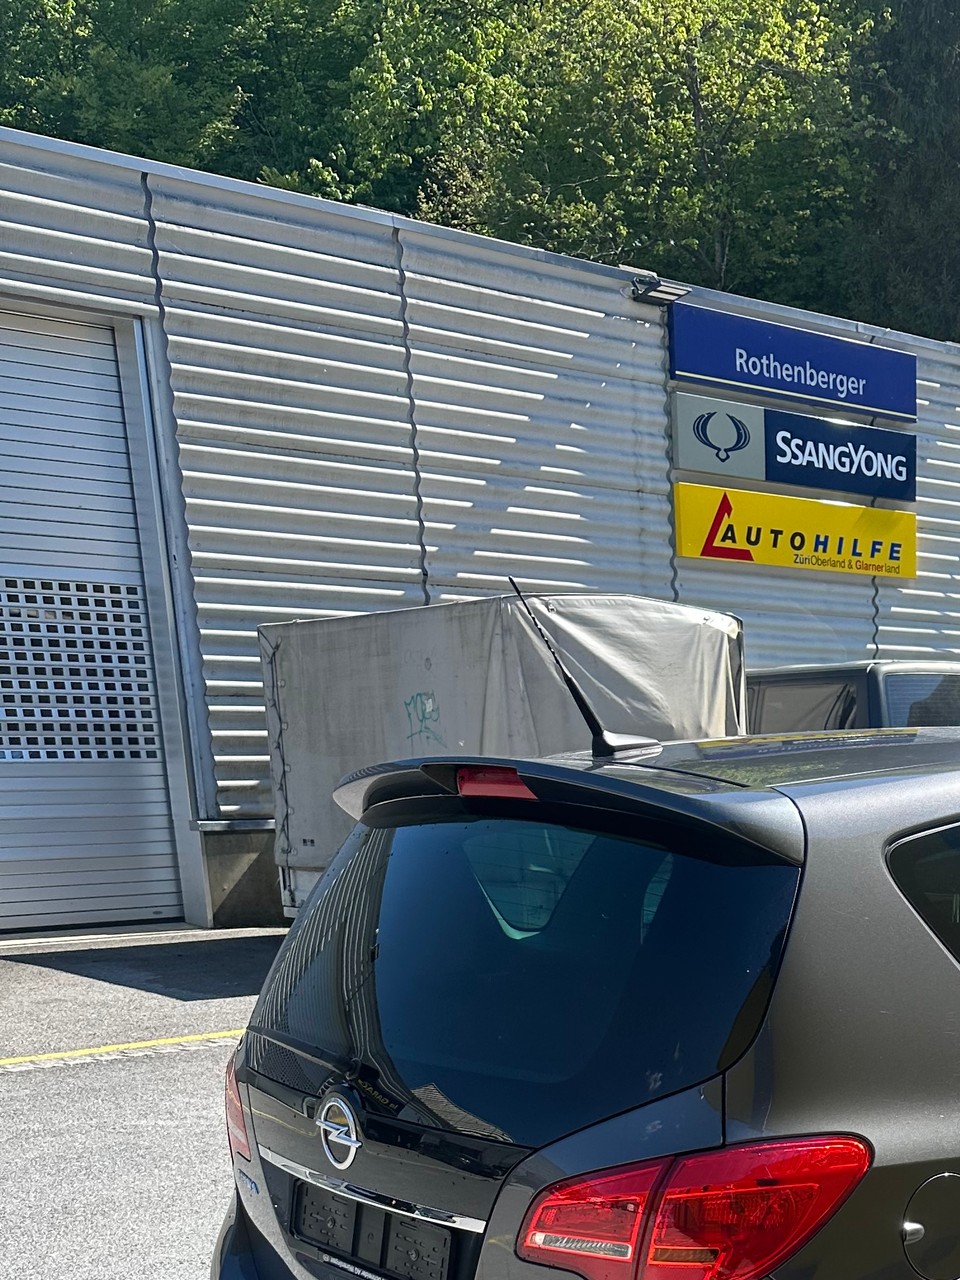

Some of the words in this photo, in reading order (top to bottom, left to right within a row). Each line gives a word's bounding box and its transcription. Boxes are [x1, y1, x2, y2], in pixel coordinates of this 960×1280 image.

[735, 348, 866, 398] Rothenberger
[776, 431, 907, 482] SSANGYONG
[721, 524, 902, 561] AUTOHILFE
[793, 553, 845, 569] ZüriOberland
[848, 559, 853, 570] &
[855, 560, 900, 574] Glarnerland
